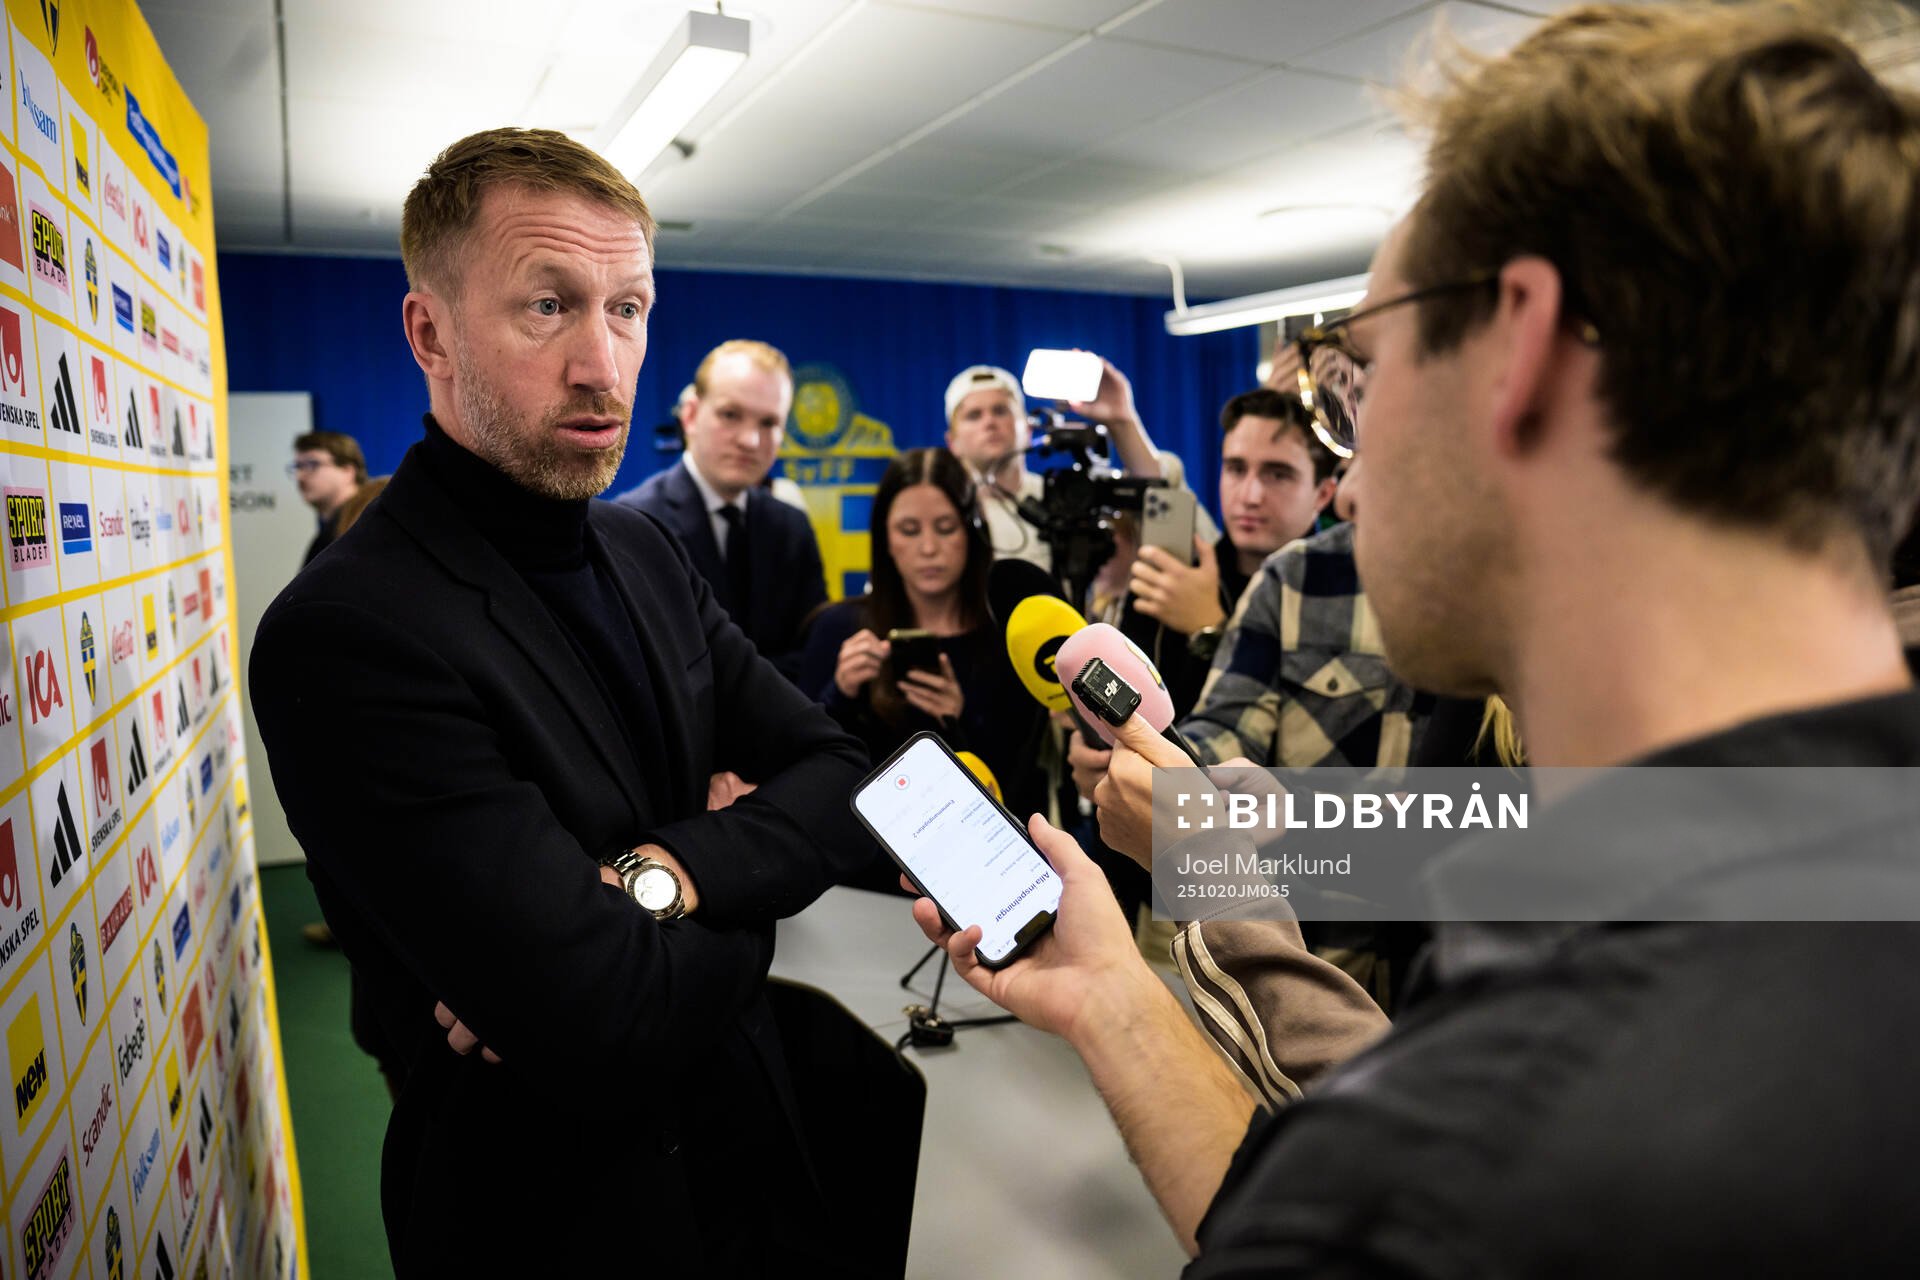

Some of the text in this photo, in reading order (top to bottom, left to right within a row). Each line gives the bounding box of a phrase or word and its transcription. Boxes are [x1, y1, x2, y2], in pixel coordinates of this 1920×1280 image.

[24, 410, 40, 430] SPEL
[6, 494, 47, 547] SPORT
[13, 546, 49, 563] BLADET
[25, 646, 63, 725] ICA
[136, 843, 157, 907] ICA
[995, 871, 1050, 923] Alla inspelningar
[0, 908, 39, 968] NSKA SPEL
[82, 1083, 112, 1168] Scandic
[24, 1156, 71, 1280] SPORT
